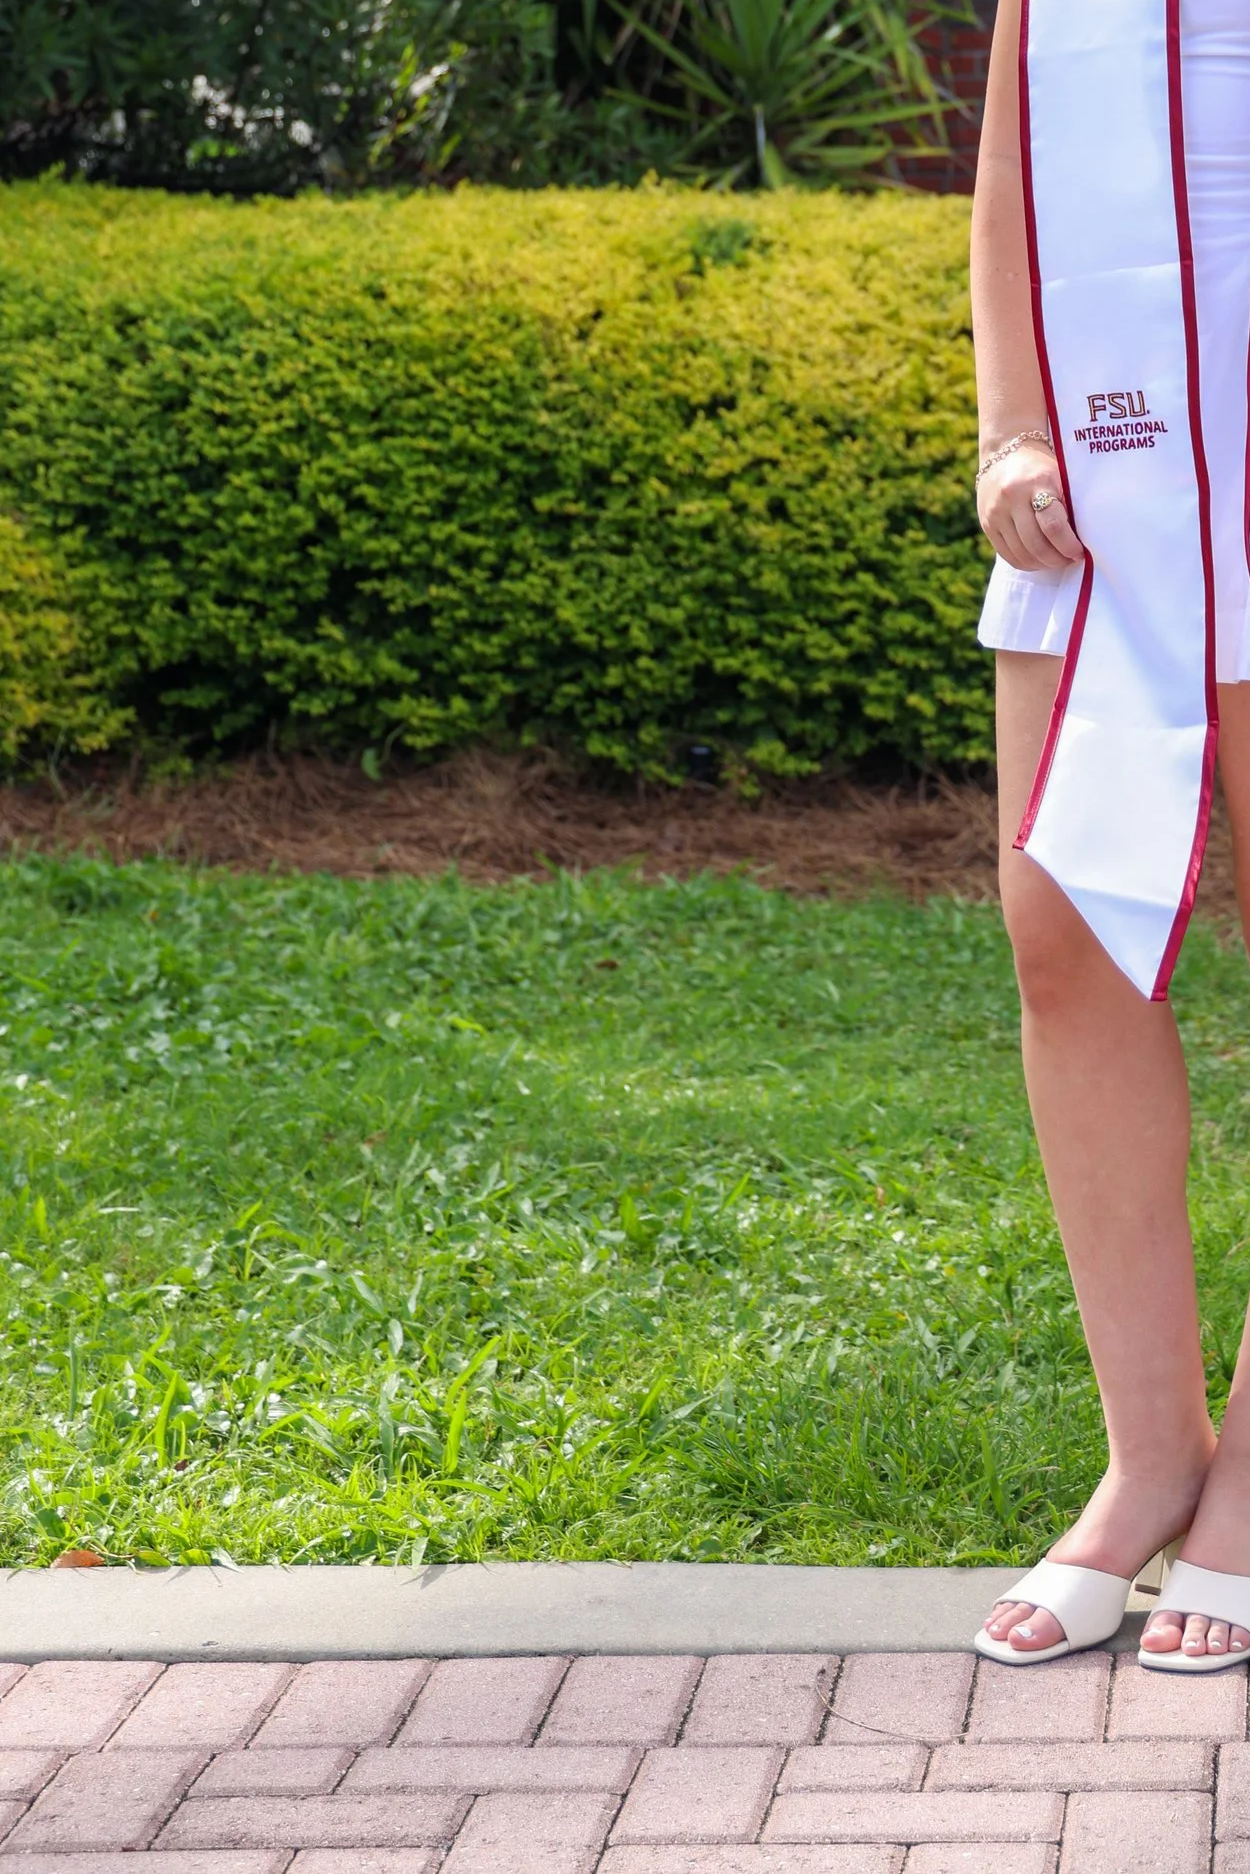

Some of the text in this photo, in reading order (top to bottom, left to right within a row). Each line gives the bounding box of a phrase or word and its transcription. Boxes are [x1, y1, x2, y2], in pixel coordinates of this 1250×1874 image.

[1087, 390, 1147, 422] FSU
[1074, 420, 1168, 441] INTERNATIONAL
[1089, 435, 1155, 454] PROGRAMS
